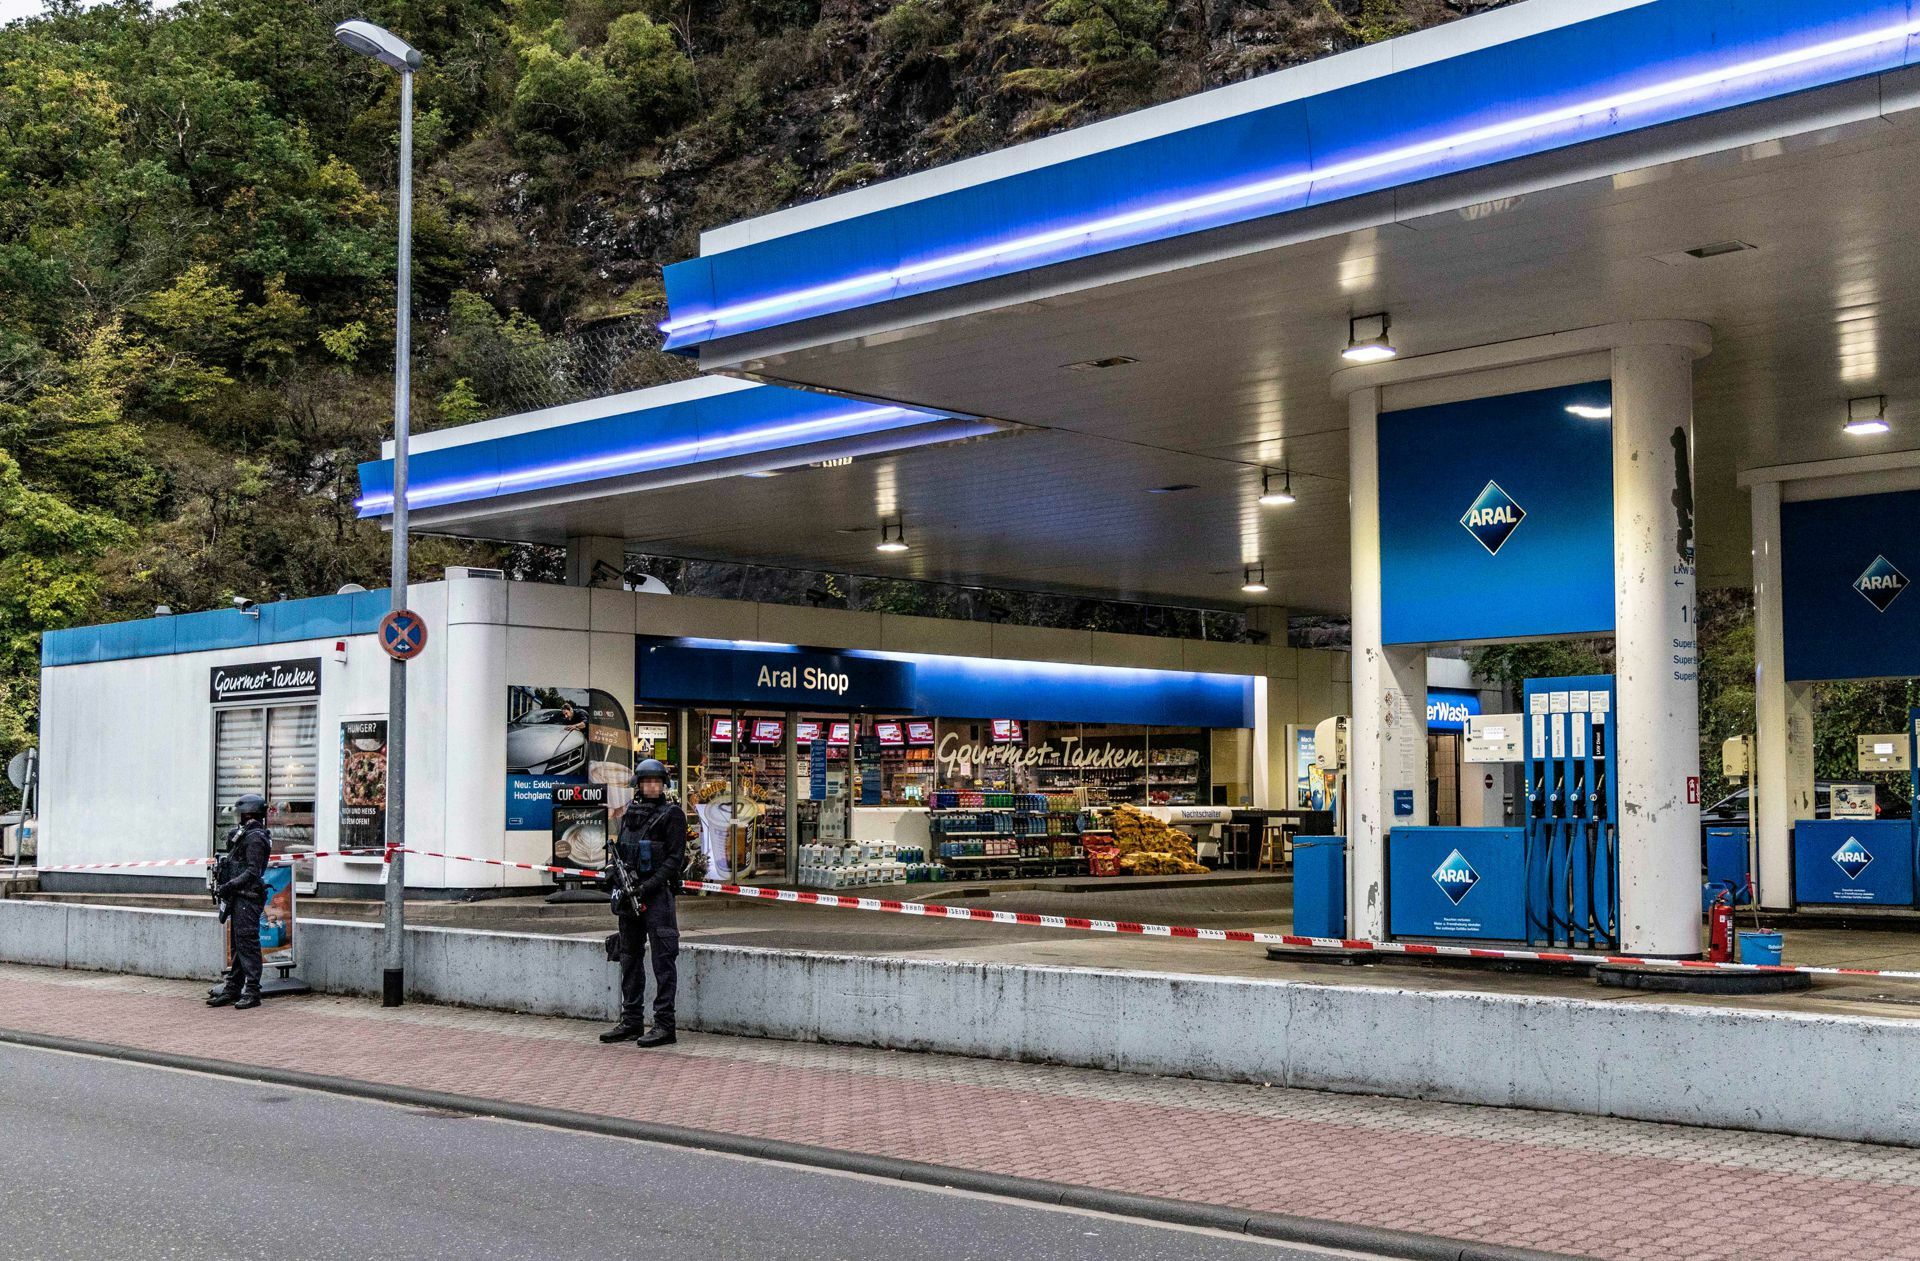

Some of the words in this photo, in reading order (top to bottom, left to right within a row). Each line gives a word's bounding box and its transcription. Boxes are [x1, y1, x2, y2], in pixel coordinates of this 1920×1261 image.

[1469, 505, 1517, 527] ARAL
[1860, 574, 1902, 590] ARAL
[1682, 605, 1687, 622] 1
[214, 665, 317, 700] Gourmet-Tanken
[757, 664, 797, 689] Aral
[803, 667, 849, 695] Shop
[347, 723, 377, 733] HUNGER?
[1465, 718, 1472, 735] 1
[937, 732, 1143, 778] Gourmet-Tanken
[514, 780, 531, 789] Neu:
[700, 781, 728, 799] Coffee
[557, 786, 602, 801] CUP&CINO
[362, 807, 376, 815] HEISS
[1181, 809, 1221, 819] Nachtschalter
[356, 817, 370, 826] OFEN!
[1837, 852, 1868, 862] ARAL
[1438, 869, 1473, 883] ARAL
